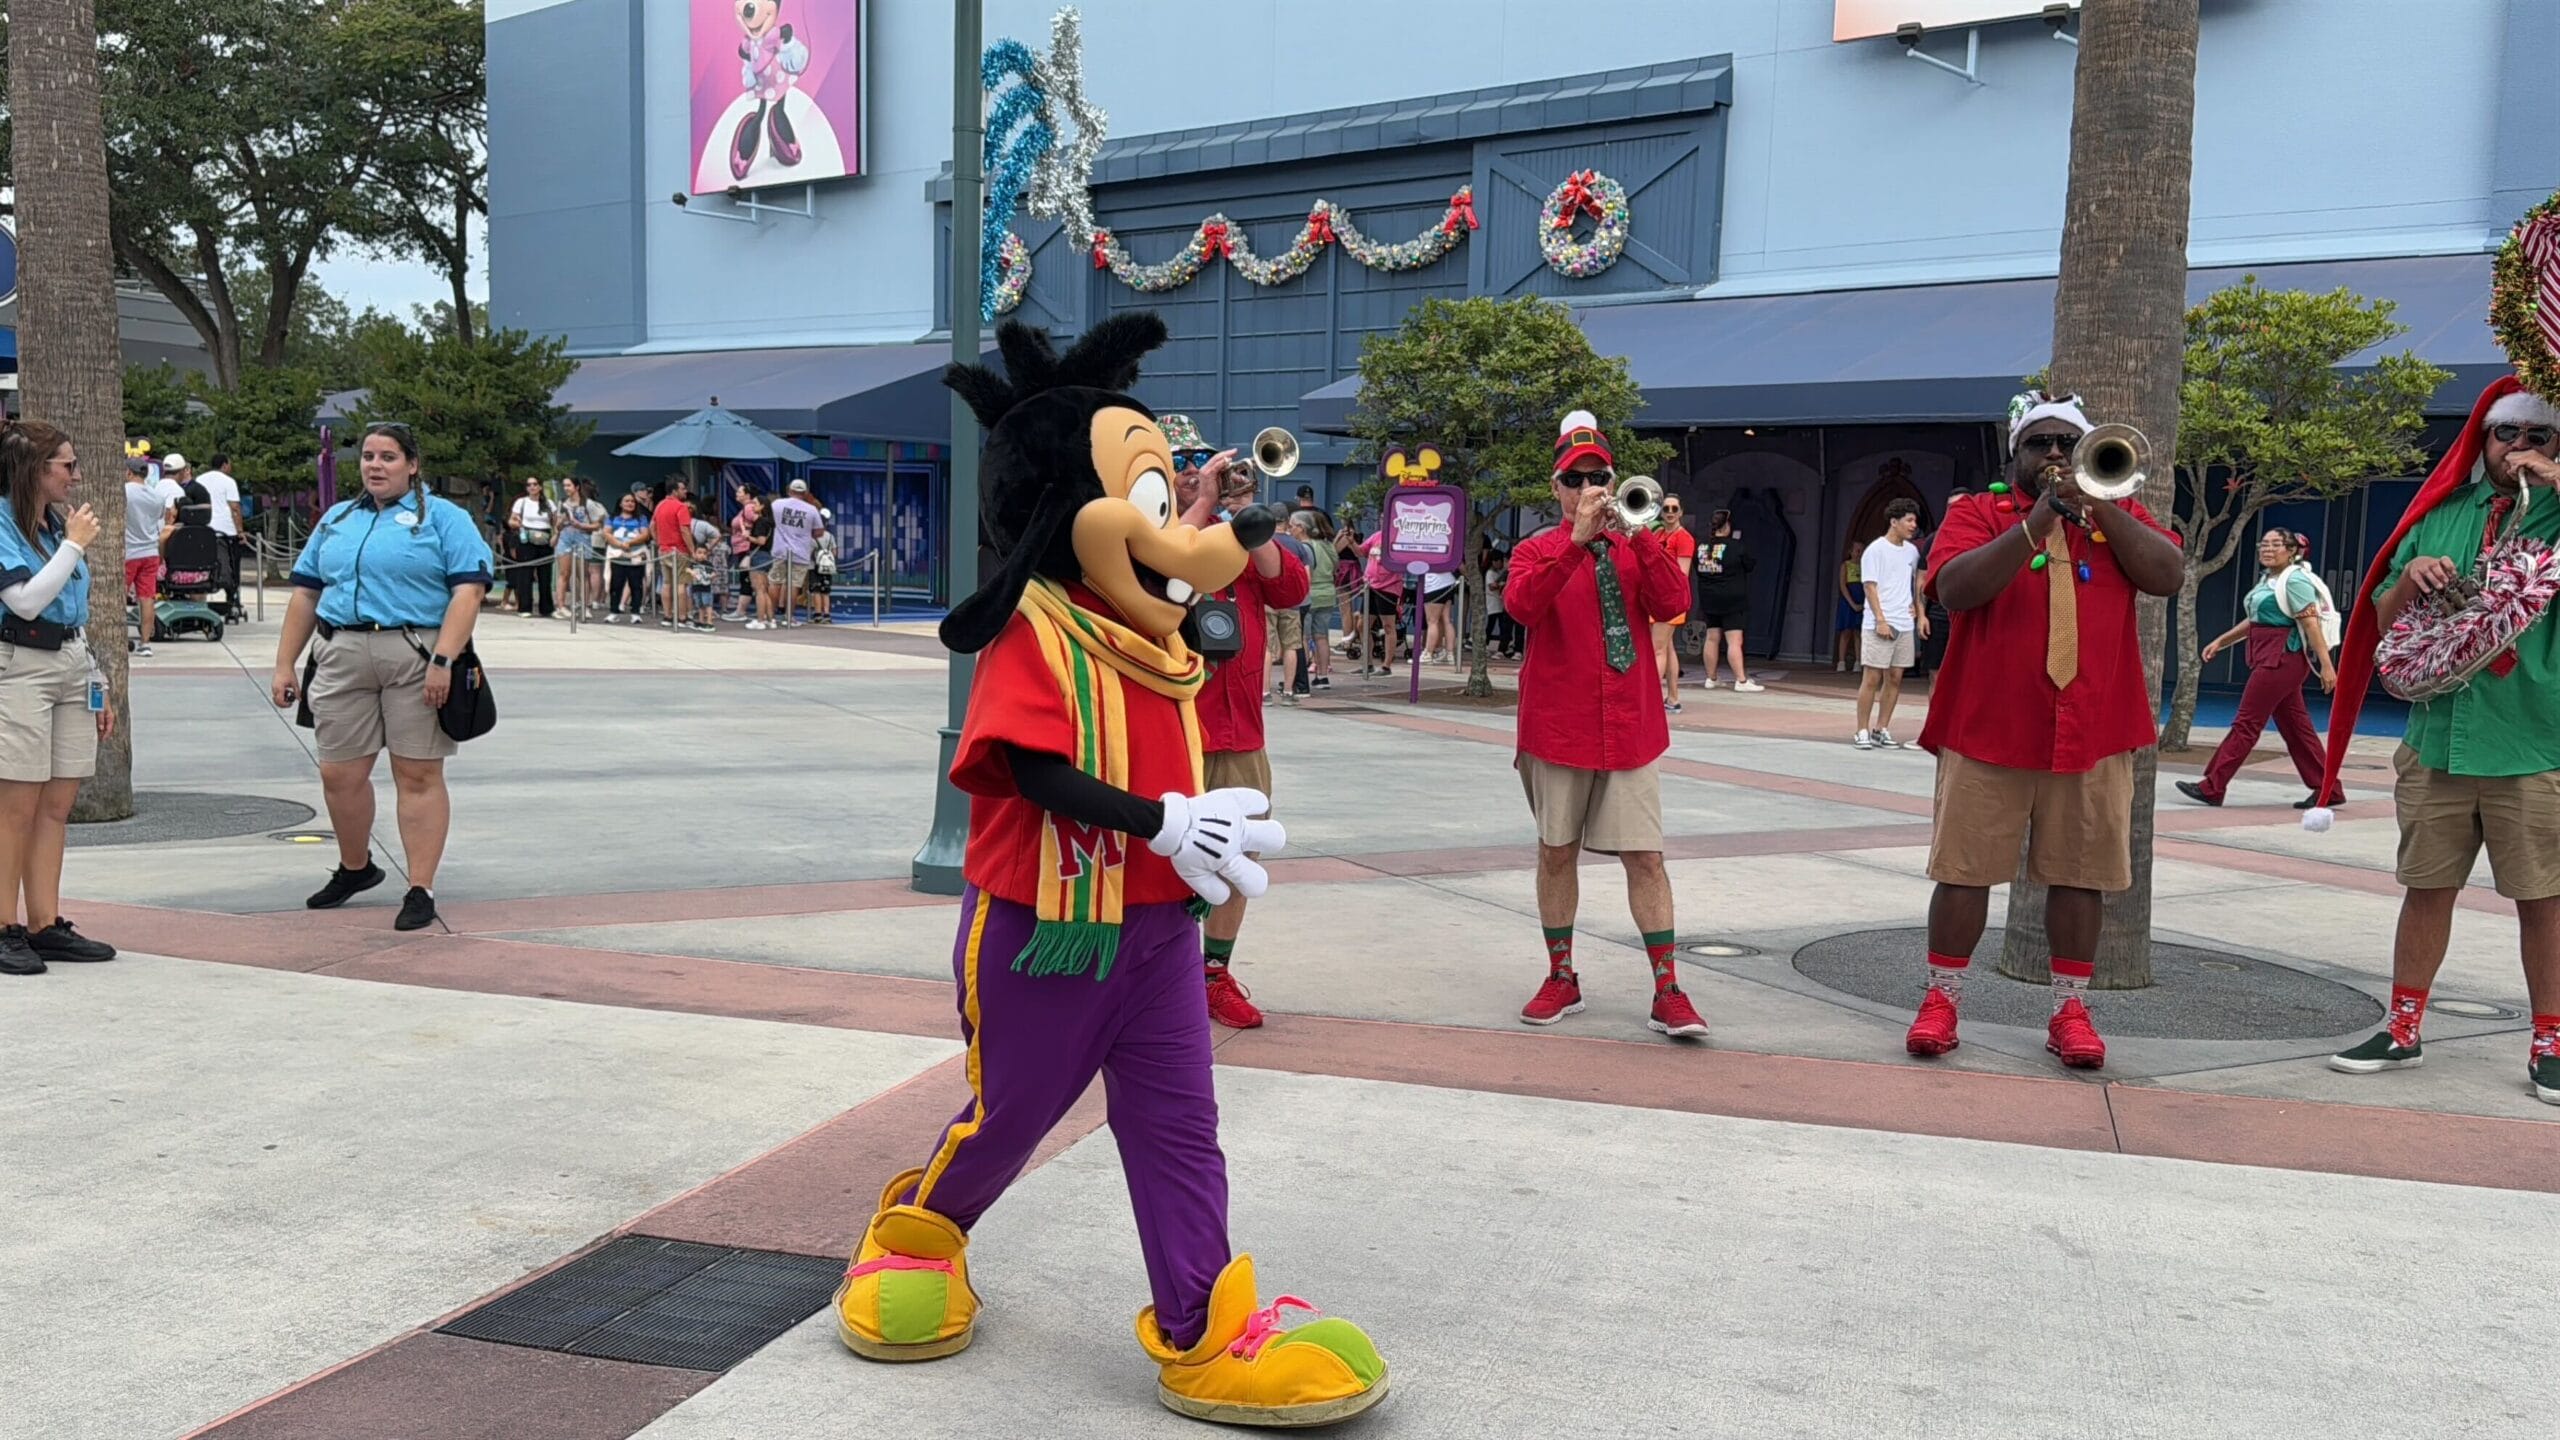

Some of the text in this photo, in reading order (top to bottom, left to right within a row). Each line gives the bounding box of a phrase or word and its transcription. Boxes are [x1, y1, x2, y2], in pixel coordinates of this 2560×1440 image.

[781, 517, 804, 529] ERA
[1395, 515, 1449, 540] Vampirina
[1048, 811, 1125, 880] M
